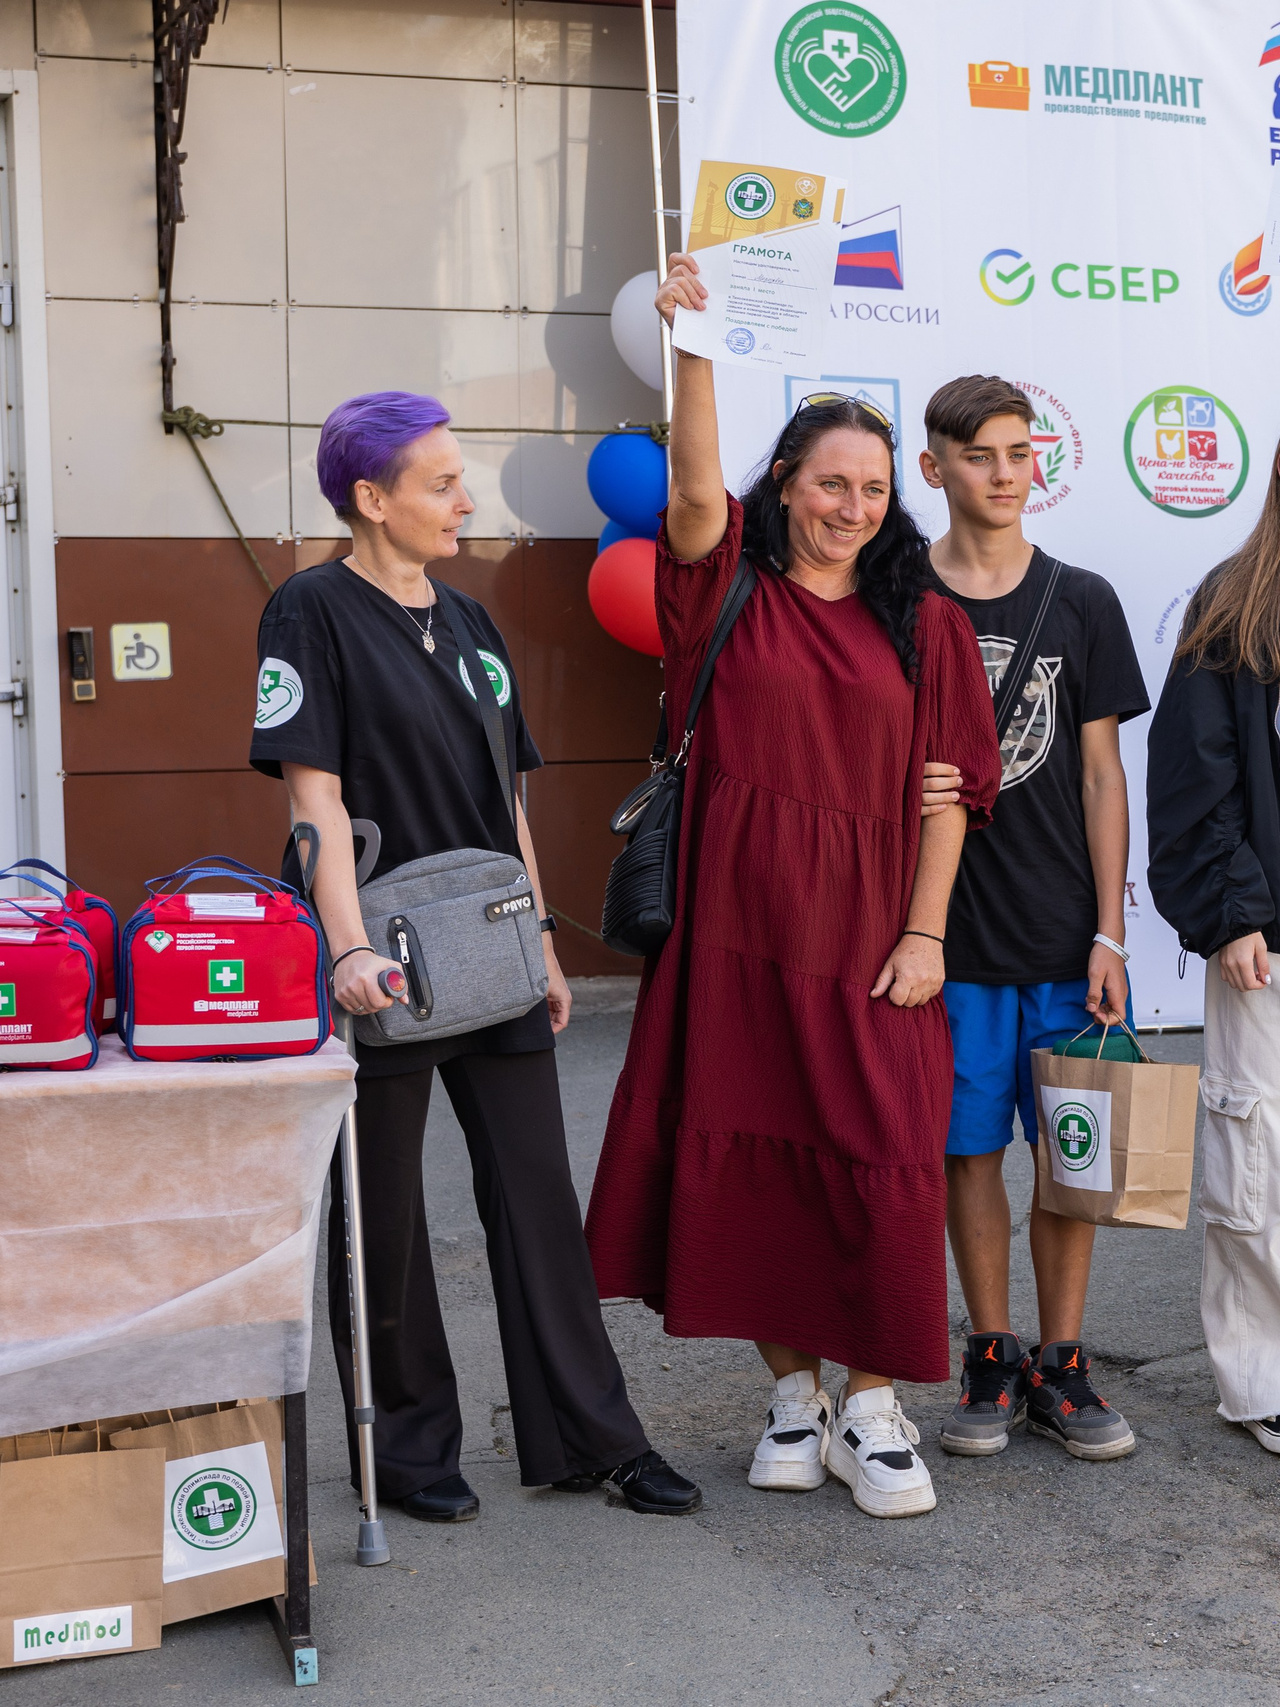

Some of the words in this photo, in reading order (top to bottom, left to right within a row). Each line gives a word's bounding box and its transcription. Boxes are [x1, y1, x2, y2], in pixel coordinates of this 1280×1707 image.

[1044, 64, 1203, 109] МЕДПЛАНТ
[1044, 103, 1141, 118] производственное
[1144, 110, 1207, 126] предприятие
[733, 244, 793, 262] ГРАМОТА
[1051, 262, 1180, 303] СБЕР
[724, 316, 765, 328] Поздравляем
[844, 302, 940, 325] РОССИИ
[1047, 395, 1072, 421] МОО
[1189, 454, 1235, 471] дороже
[1158, 470, 1215, 481] качества
[1045, 484, 1071, 509] КРАЙ
[1155, 492, 1225, 506] ЦЕНТРАЛЬНЫЙ
[1155, 597, 1180, 644] Обучение
[503, 897, 531, 913] PAVO
[209, 1000, 259, 1011] медплант
[183, 1474, 220, 1494] Олимпиада
[231, 1478, 250, 1499] первой
[177, 1494, 197, 1541] Тихоокеанская
[240, 1500, 251, 1527] помощи
[230, 1531, 238, 1539] 2024
[24, 1617, 121, 1649] MedMod
